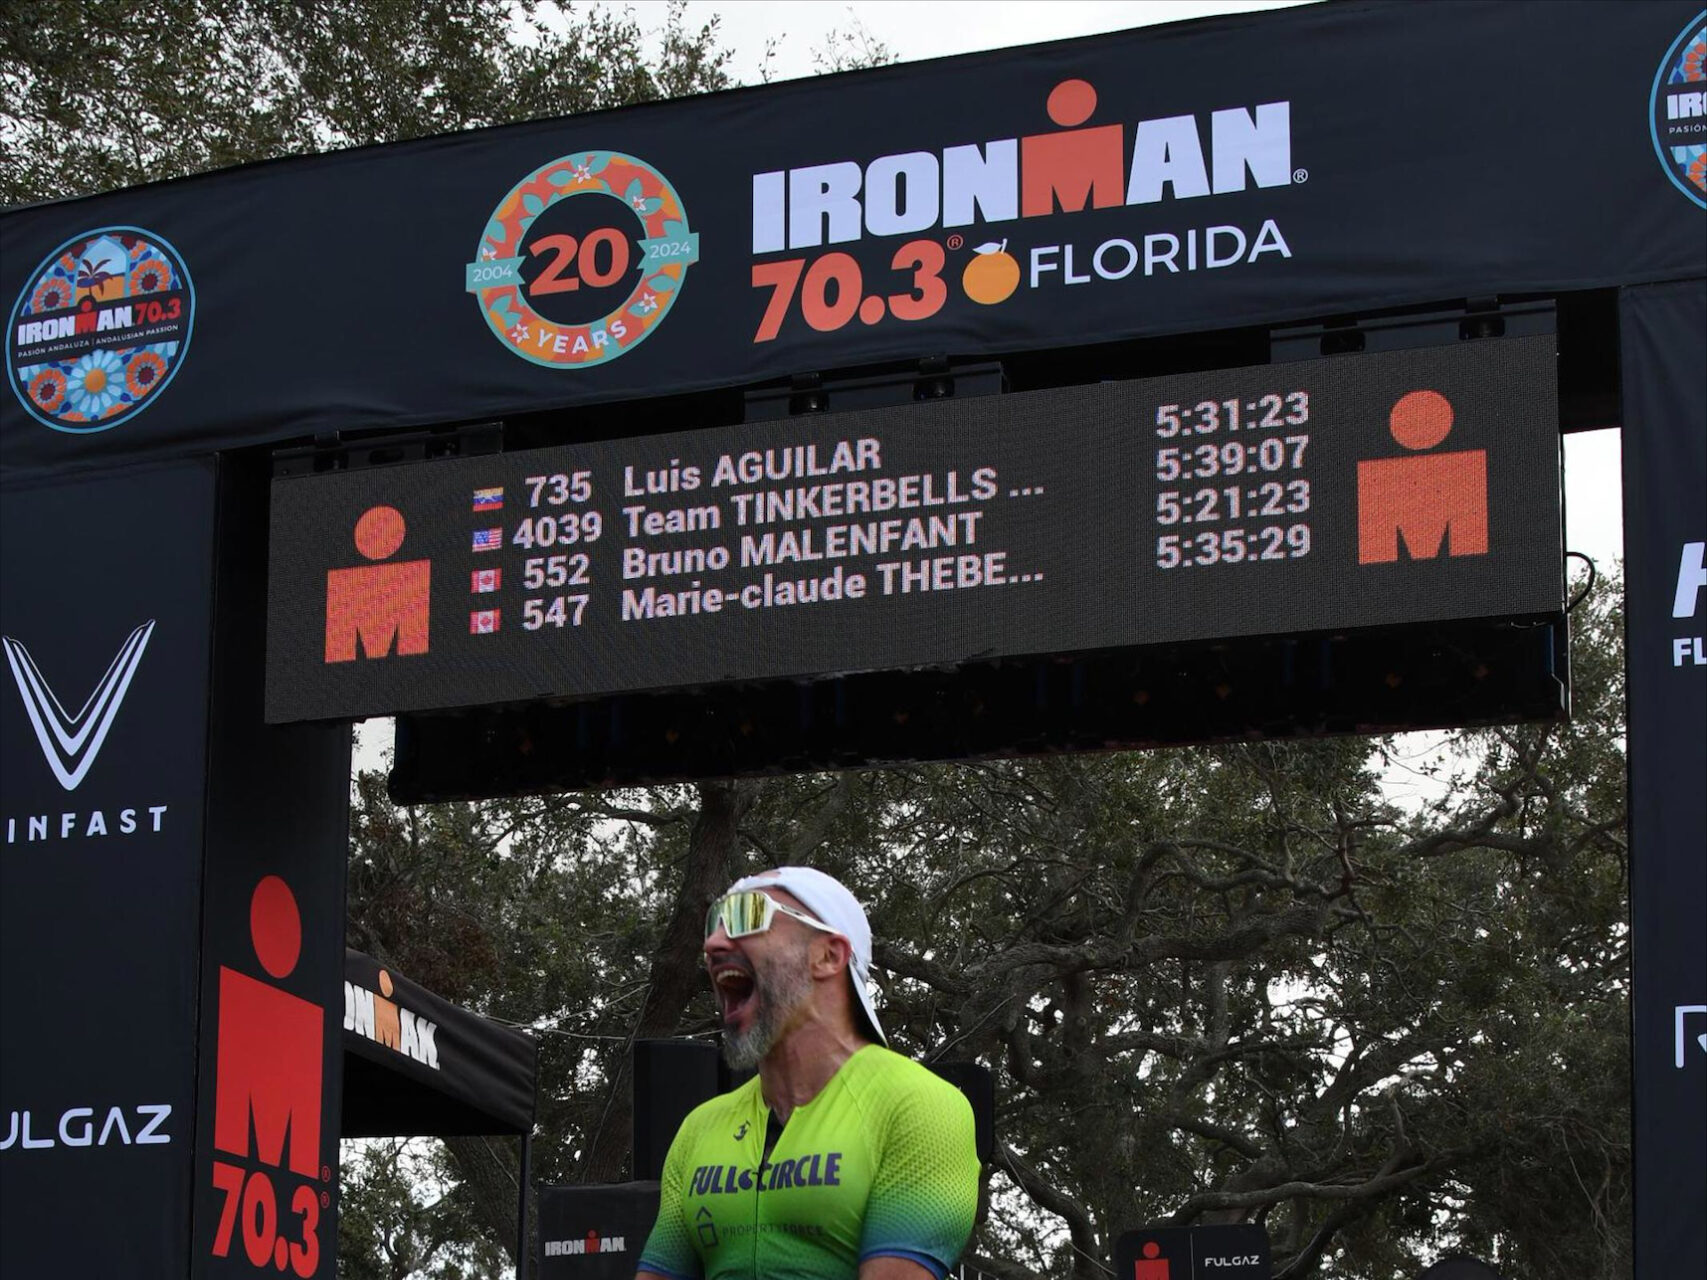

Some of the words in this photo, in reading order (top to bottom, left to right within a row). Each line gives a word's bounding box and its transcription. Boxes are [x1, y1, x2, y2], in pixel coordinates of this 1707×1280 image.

[752, 79, 1291, 254] IRONMAN
[473, 264, 512, 282] 2004
[529, 227, 630, 296] 20
[650, 241, 692, 259] 2024
[751, 239, 948, 344] 70.3
[1029, 219, 1292, 288] FLORIDA
[18, 300, 132, 345] IRONMAN
[134, 297, 181, 325] 70.3
[48, 340, 90, 352] ANDALUZA
[95, 331, 144, 345] ANDALUSIAN
[146, 324, 179, 335] PASSION
[536, 319, 627, 354] YEARS
[525, 471, 591, 507] 735
[624, 459, 701, 497] Luis
[711, 438, 882, 487] AGUILAR
[1156, 391, 1310, 437] 5:31:23
[512, 511, 602, 549] 4039
[622, 505, 720, 537] Team
[731, 467, 998, 526] TINKERBELLS
[1156, 435, 1310, 481] 5:39:07
[523, 553, 590, 590] 552
[623, 546, 730, 580] Bruno
[740, 511, 984, 568] MALENFANT
[1156, 479, 1311, 525] 5:21:23
[522, 594, 590, 631] 547
[621, 565, 867, 622] Marie-claude
[1156, 523, 1312, 569] 5:35:29
[212, 1161, 320, 1279] 70.3
[545, 1229, 626, 1256] IRONMAN
[1204, 1254, 1260, 1268] FULGAZ
